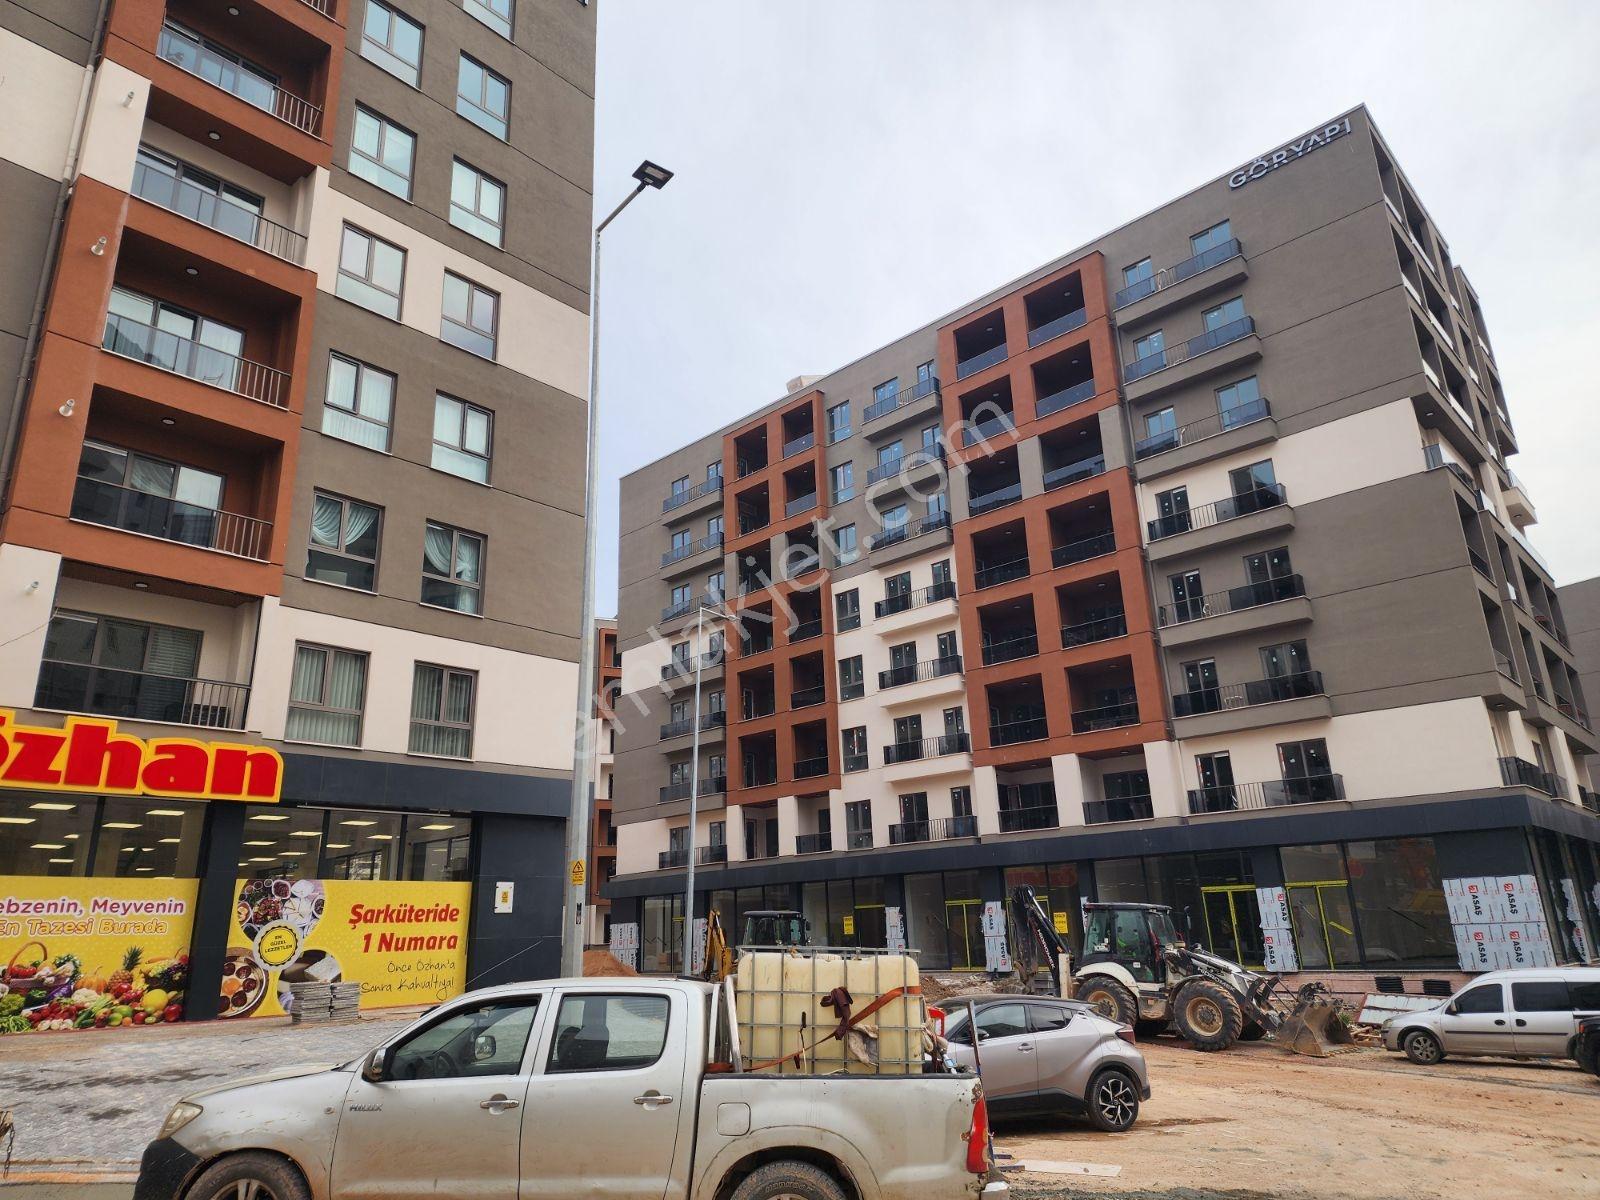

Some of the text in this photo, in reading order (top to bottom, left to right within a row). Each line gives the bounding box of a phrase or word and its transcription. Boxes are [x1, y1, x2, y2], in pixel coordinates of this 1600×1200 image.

[1228, 117, 1352, 188] GÖRYAPI
[0, 714, 280, 799] zhan
[91, 899, 184, 916] Meyvenin
[348, 903, 459, 930] Şarküteride
[27, 918, 94, 936] Tazesi
[99, 918, 169, 934] Burada
[363, 933, 458, 953] 1 Numara
[361, 982, 392, 994] Sonra
